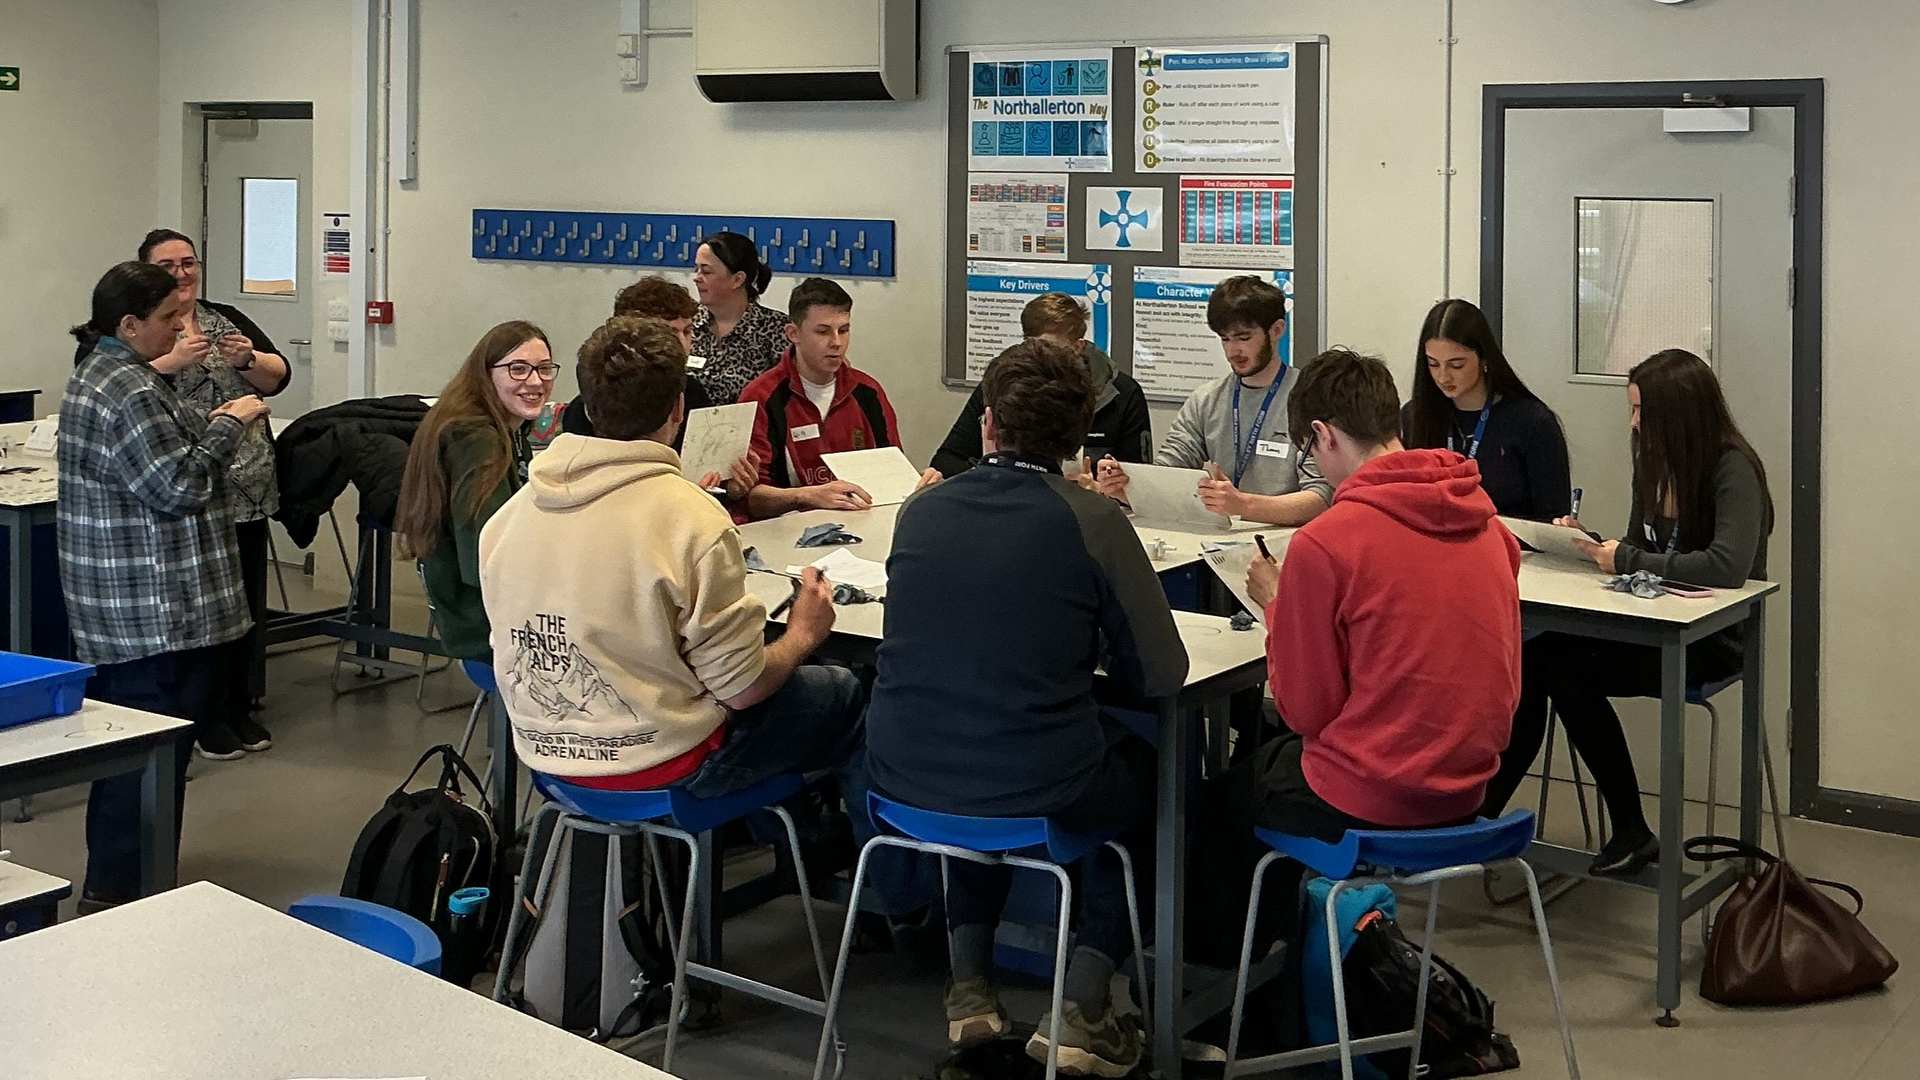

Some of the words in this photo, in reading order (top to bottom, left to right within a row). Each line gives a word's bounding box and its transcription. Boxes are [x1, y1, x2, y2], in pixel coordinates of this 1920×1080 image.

[1146, 83, 1154, 92] P
[973, 98, 988, 110] The
[993, 98, 1085, 115] Northallerton
[1089, 103, 1108, 120] Way
[1146, 100, 1154, 110] R
[1146, 118, 1154, 128] O
[1146, 137, 1154, 147] U
[1147, 155, 1154, 165] D
[1000, 279, 1016, 291] Key
[1018, 280, 1050, 290] Drivers
[1157, 286, 1203, 298] Character
[536, 613, 566, 635] THE
[510, 628, 567, 653] FRENCH
[531, 650, 571, 672] ALPS
[528, 733, 553, 745] GOOD
[556, 736, 565, 745] IN
[568, 736, 595, 748] WHITE
[598, 735, 655, 748] PARADISE
[535, 744, 620, 761] ADRENALINE
